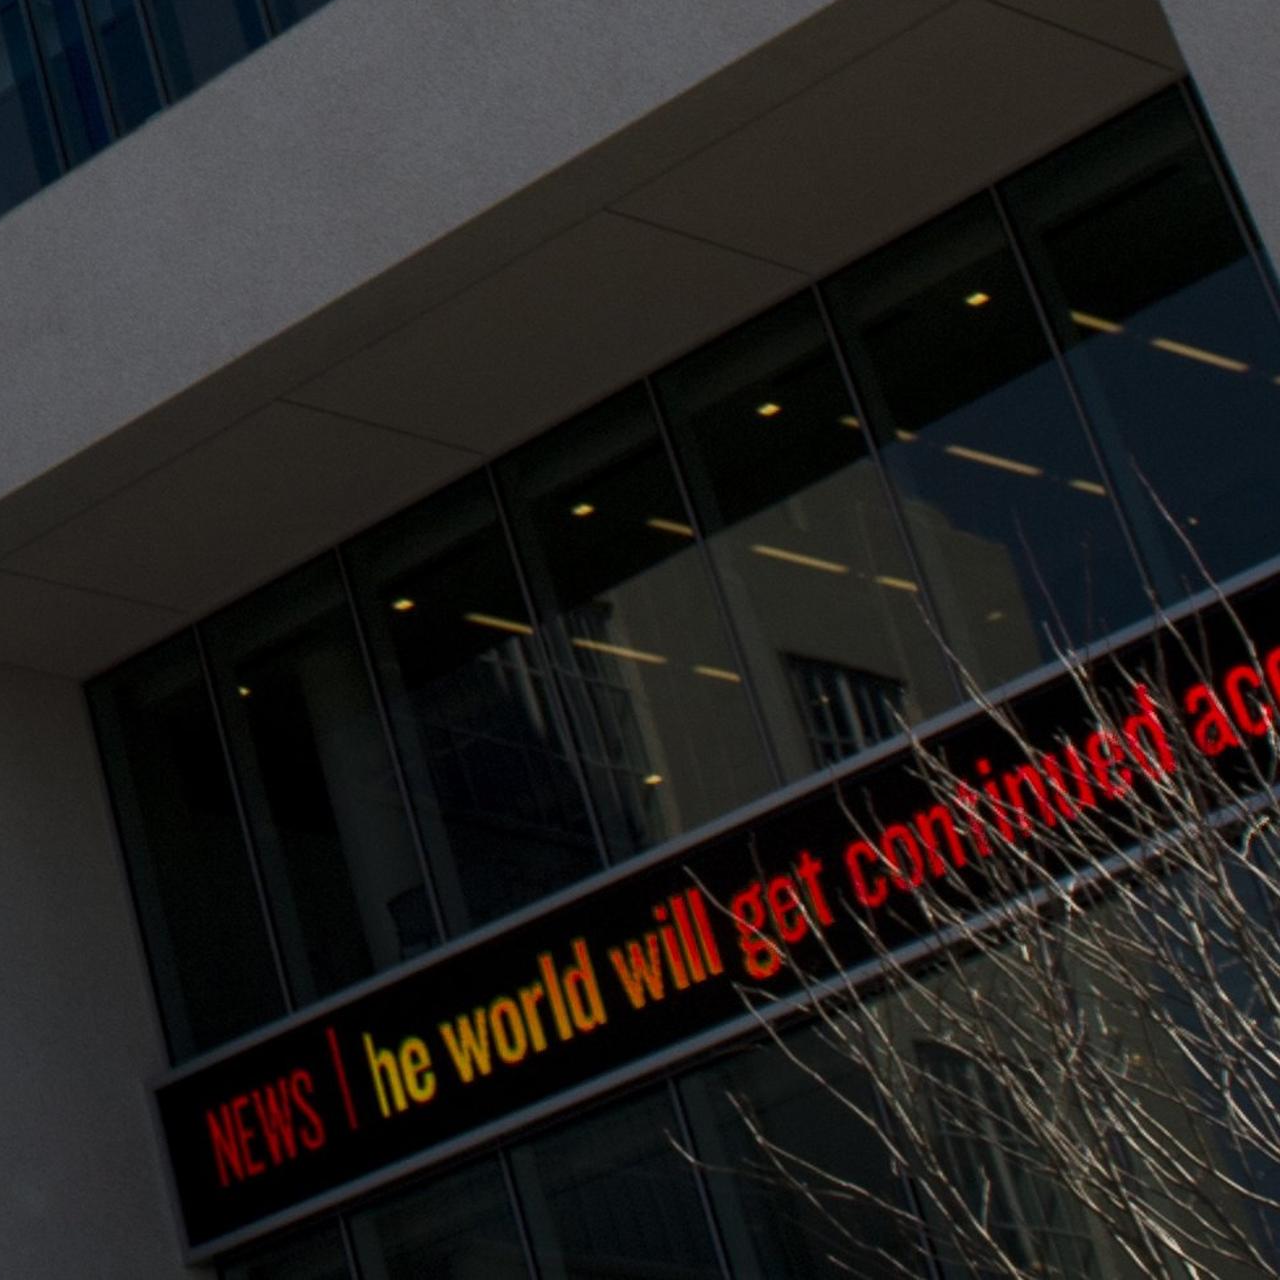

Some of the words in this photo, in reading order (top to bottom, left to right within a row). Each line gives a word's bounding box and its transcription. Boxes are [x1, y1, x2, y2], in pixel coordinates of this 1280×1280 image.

[206, 1068, 326, 1188] NEWS
[364, 1033, 437, 1118] he
[440, 939, 608, 1083] world
[609, 888, 724, 1009] will
[730, 850, 834, 980] get
[845, 683, 1177, 908] continued
